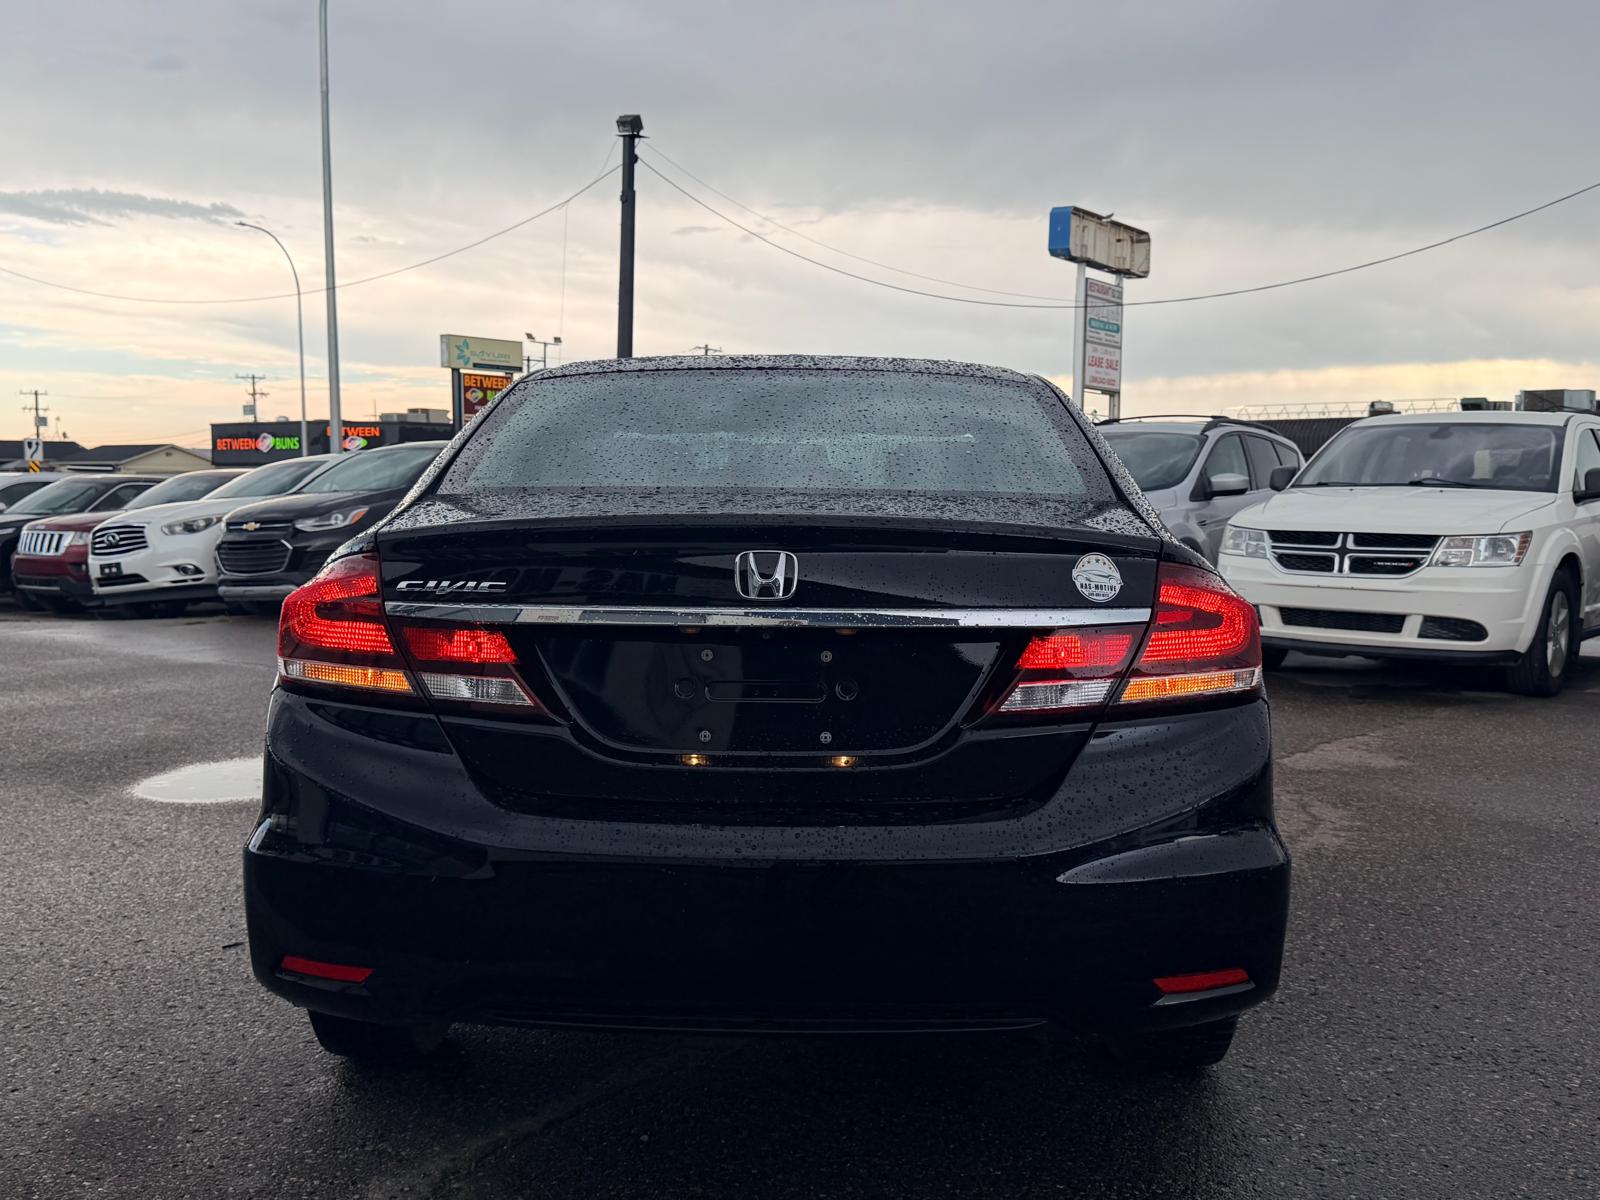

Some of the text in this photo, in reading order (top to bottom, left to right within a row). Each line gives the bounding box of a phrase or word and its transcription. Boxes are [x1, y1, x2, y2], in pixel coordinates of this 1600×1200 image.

[1088, 355, 1119, 370] LEASE SALE
[464, 375, 511, 388] BETWEEN
[217, 437, 300, 450] BETWEEN BUNS
[396, 580, 507, 595] CIVIC
[1080, 582, 1116, 592] NAS-MOTIVE
